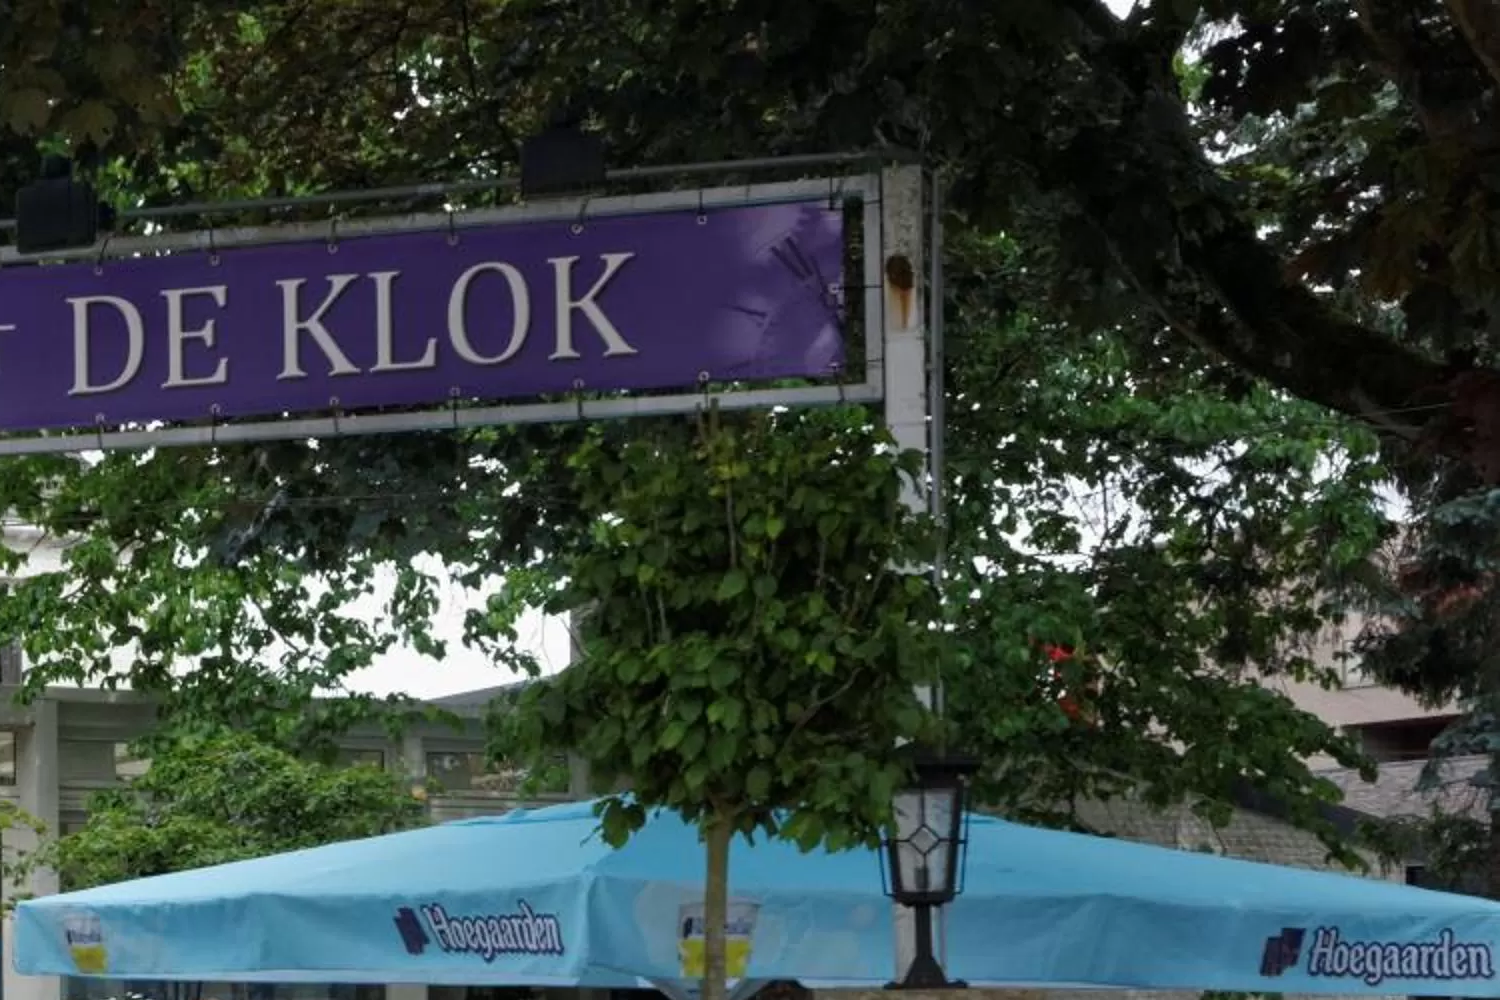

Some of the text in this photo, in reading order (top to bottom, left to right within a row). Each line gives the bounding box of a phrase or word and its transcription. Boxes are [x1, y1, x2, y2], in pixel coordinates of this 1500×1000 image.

[65, 285, 229, 396] DE
[274, 252, 638, 380] KLOK
[420, 898, 564, 962] Hoegaarden
[1309, 926, 1494, 985] Hoegaarden
